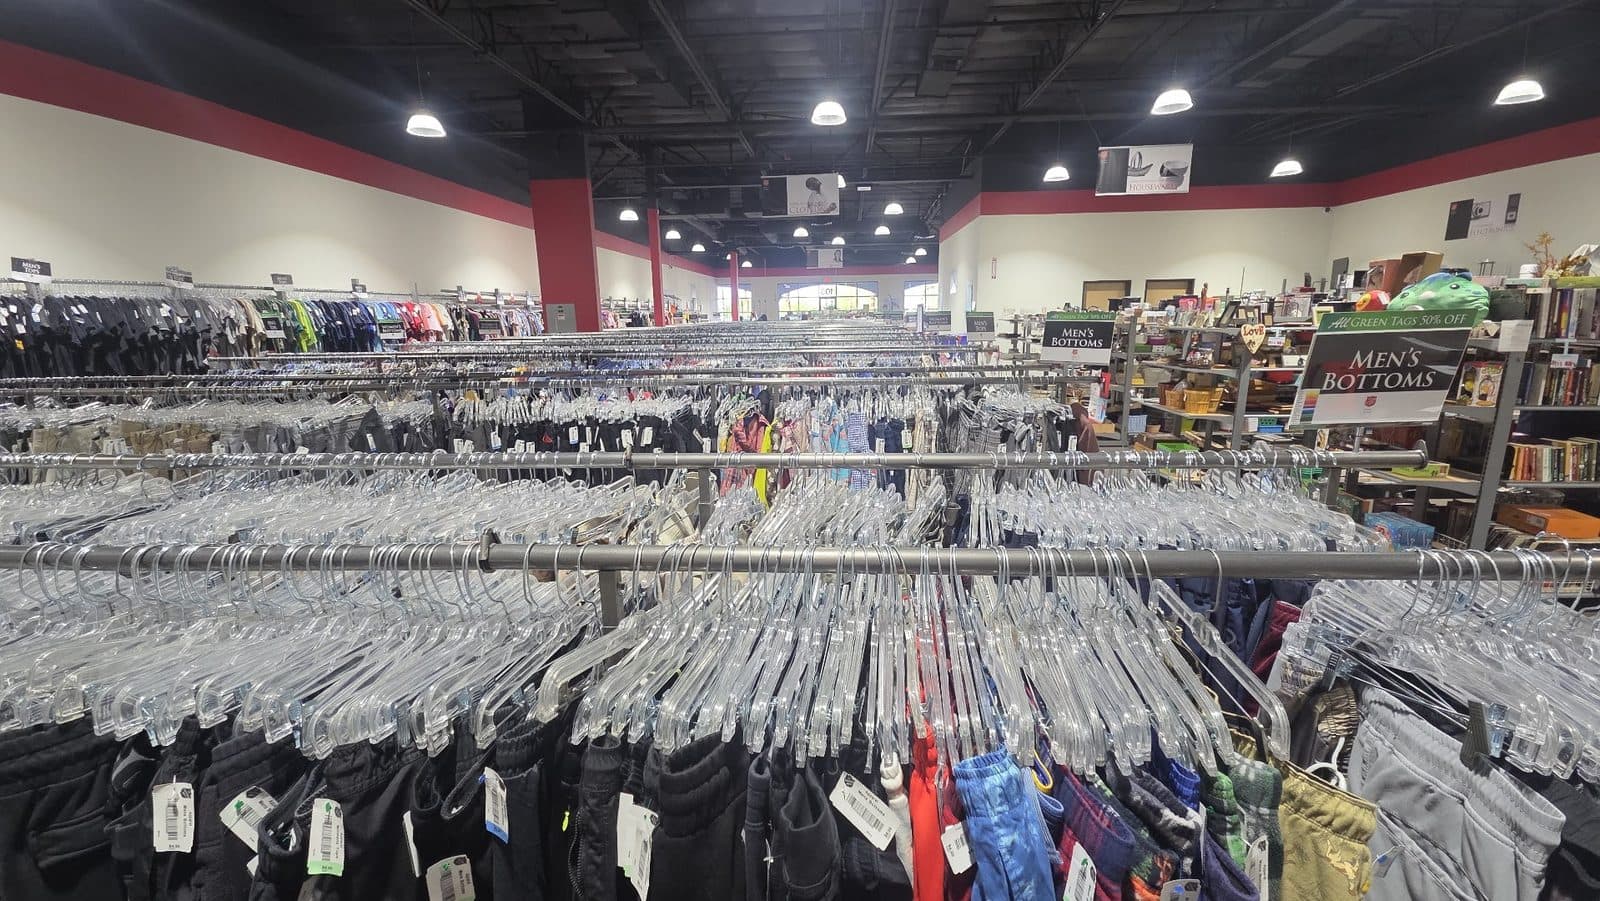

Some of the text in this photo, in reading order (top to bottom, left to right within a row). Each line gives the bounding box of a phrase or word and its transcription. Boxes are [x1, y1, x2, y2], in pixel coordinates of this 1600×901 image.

[1328, 316, 1351, 329] All
[1351, 316, 1389, 327] GREEN
[1420, 315, 1442, 325] 50%
[1445, 314, 1467, 324] OFF
[1062, 327, 1095, 338] MEN'S
[1243, 326, 1264, 336] LOVE
[1051, 337, 1104, 348] BOTTOMS
[1348, 347, 1422, 370] MEN'S
[1322, 371, 1437, 391] BOTTOMS
